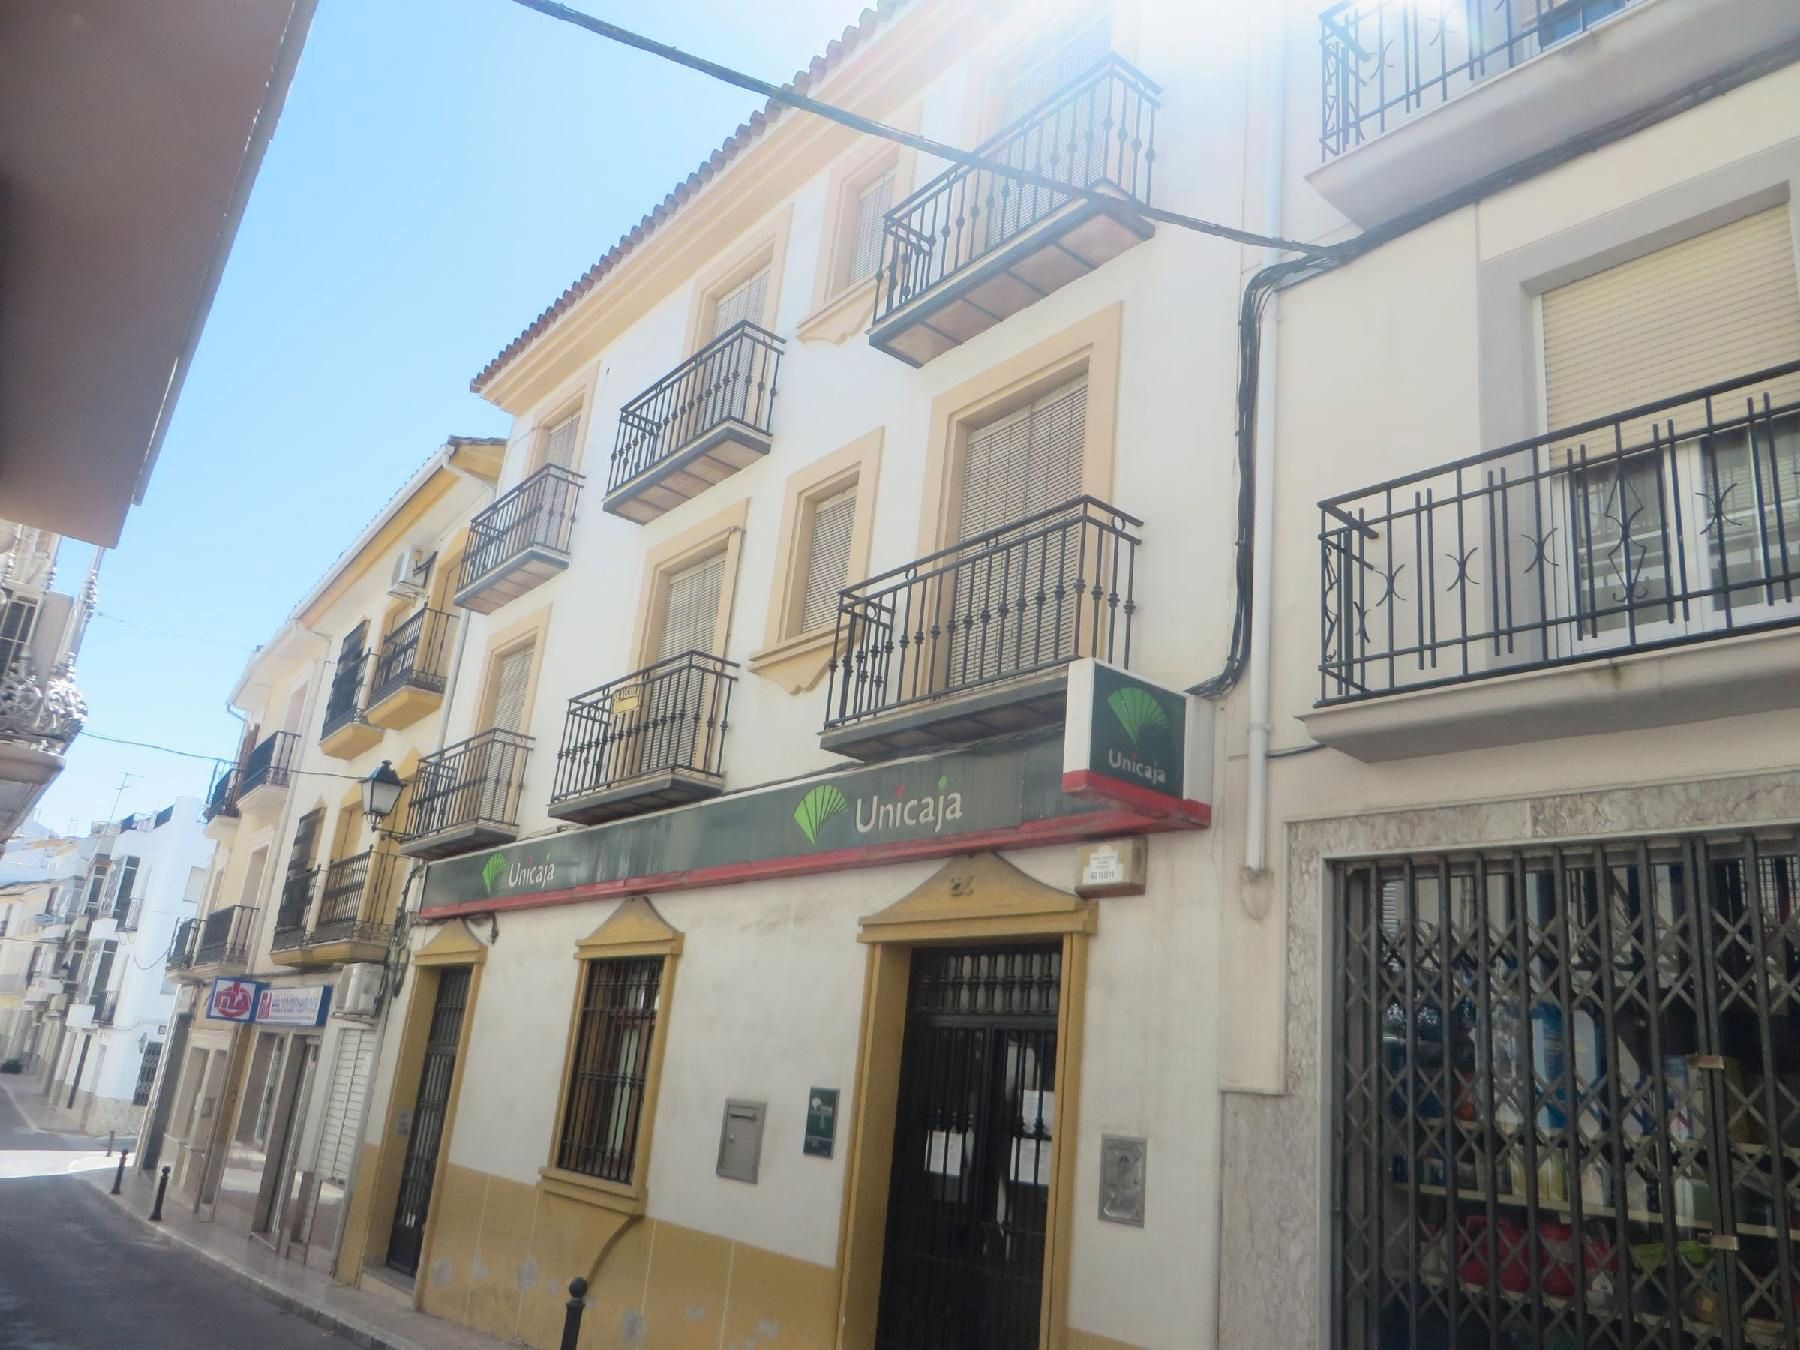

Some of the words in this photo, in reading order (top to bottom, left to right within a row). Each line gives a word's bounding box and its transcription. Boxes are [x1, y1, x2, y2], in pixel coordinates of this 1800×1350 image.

[1108, 748, 1166, 784] Unicaja
[856, 776, 962, 833] Unicaja
[509, 852, 555, 888] Unicaja
